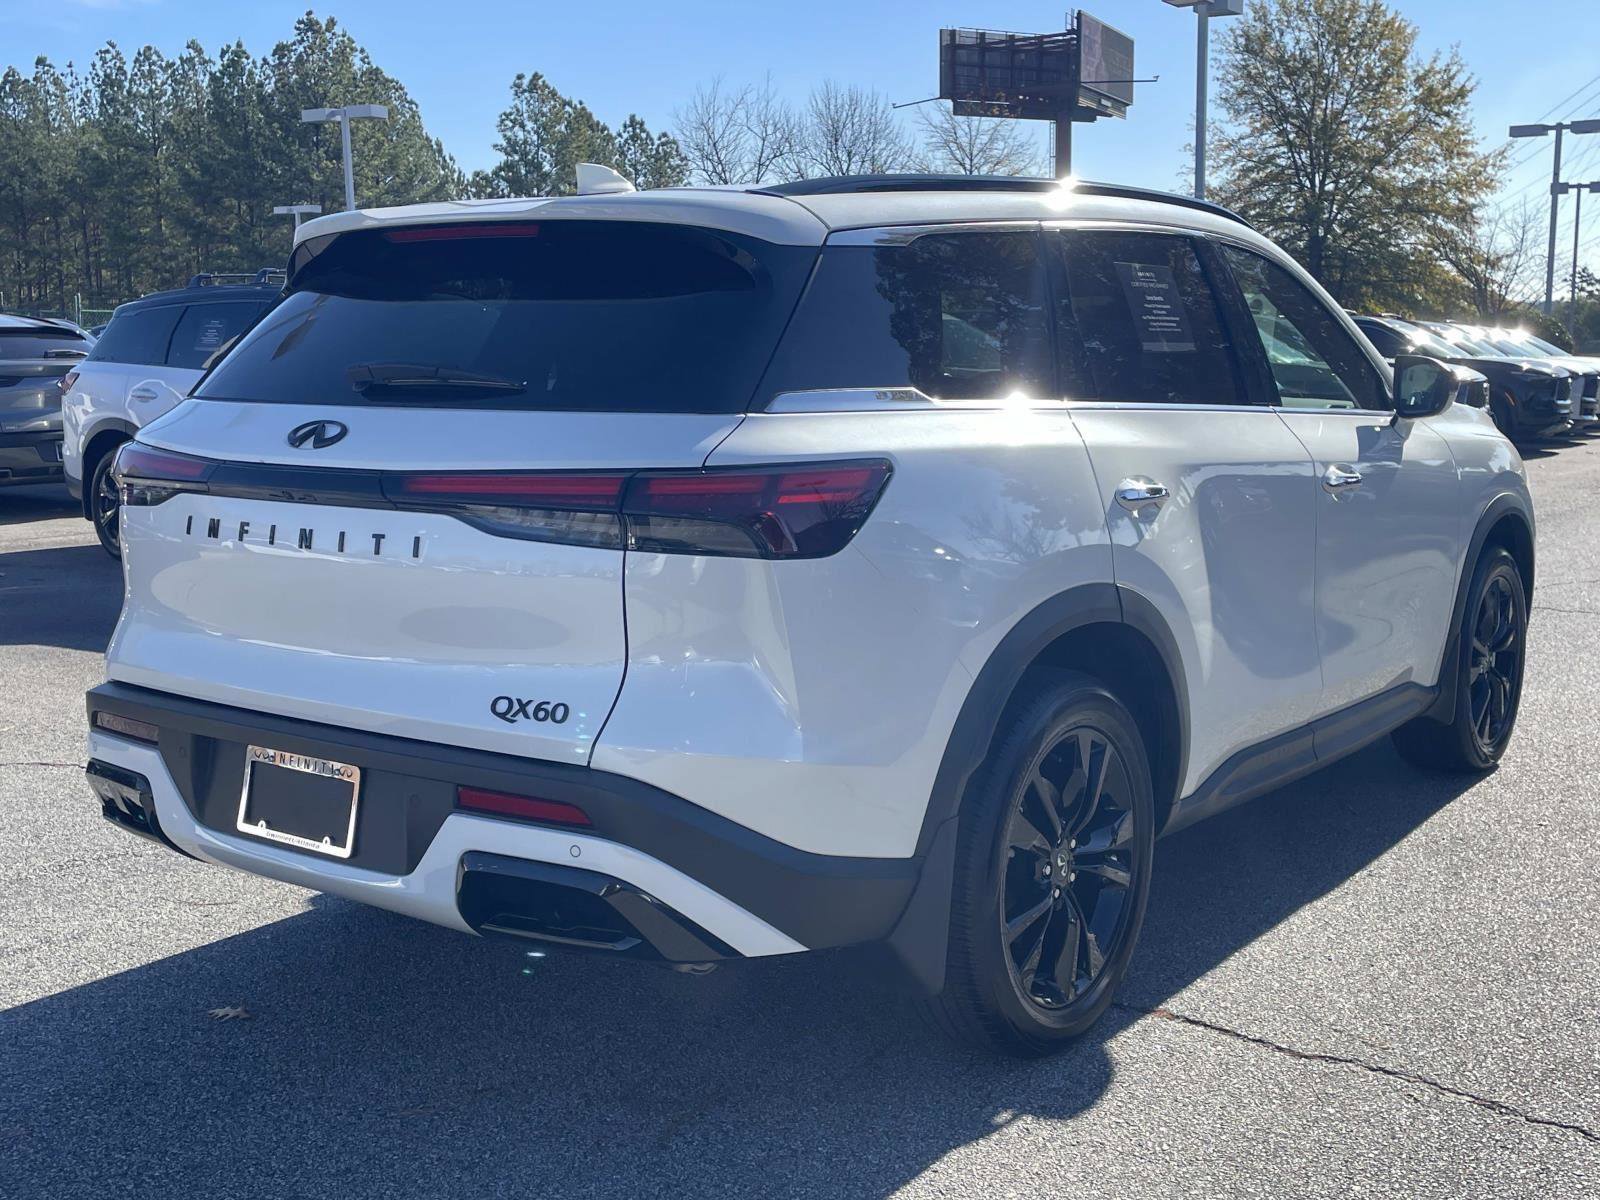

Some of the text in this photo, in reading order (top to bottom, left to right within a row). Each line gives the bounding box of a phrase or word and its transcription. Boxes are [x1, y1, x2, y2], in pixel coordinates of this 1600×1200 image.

[186, 515, 421, 558] INFINITI
[490, 695, 570, 724] QX60
[272, 752, 334, 775] INFINITI
